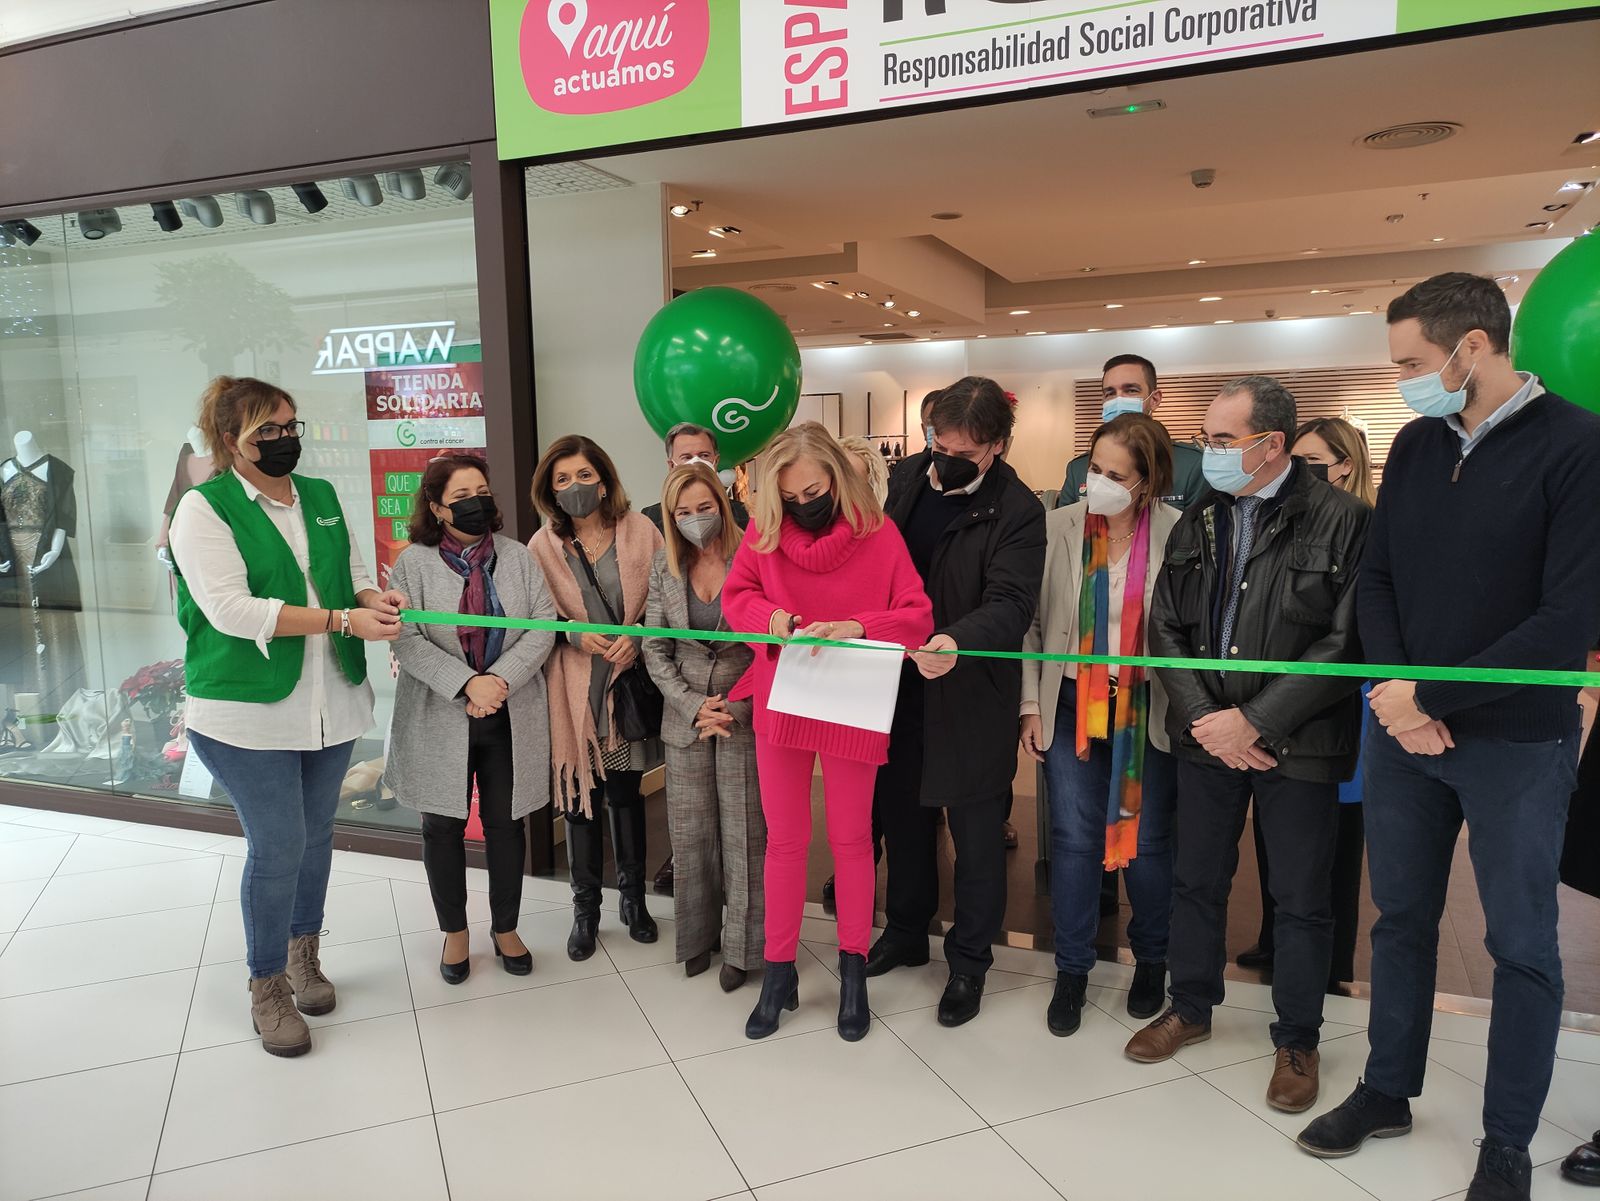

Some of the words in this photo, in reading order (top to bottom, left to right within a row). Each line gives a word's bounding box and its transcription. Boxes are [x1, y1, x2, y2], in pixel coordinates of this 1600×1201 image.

[583, 2, 676, 71] aquí
[884, 25, 1070, 88] Responsabilidad
[1080, 12, 1154, 56] Social
[1164, 0, 1317, 45] Corporativa
[784, 0, 848, 115] ESP
[553, 59, 675, 96] actuamos
[392, 373, 464, 391] TIENDA
[376, 392, 483, 412] SOLIDARIA
[388, 474, 411, 493] QUE
[381, 498, 401, 516] SEA
